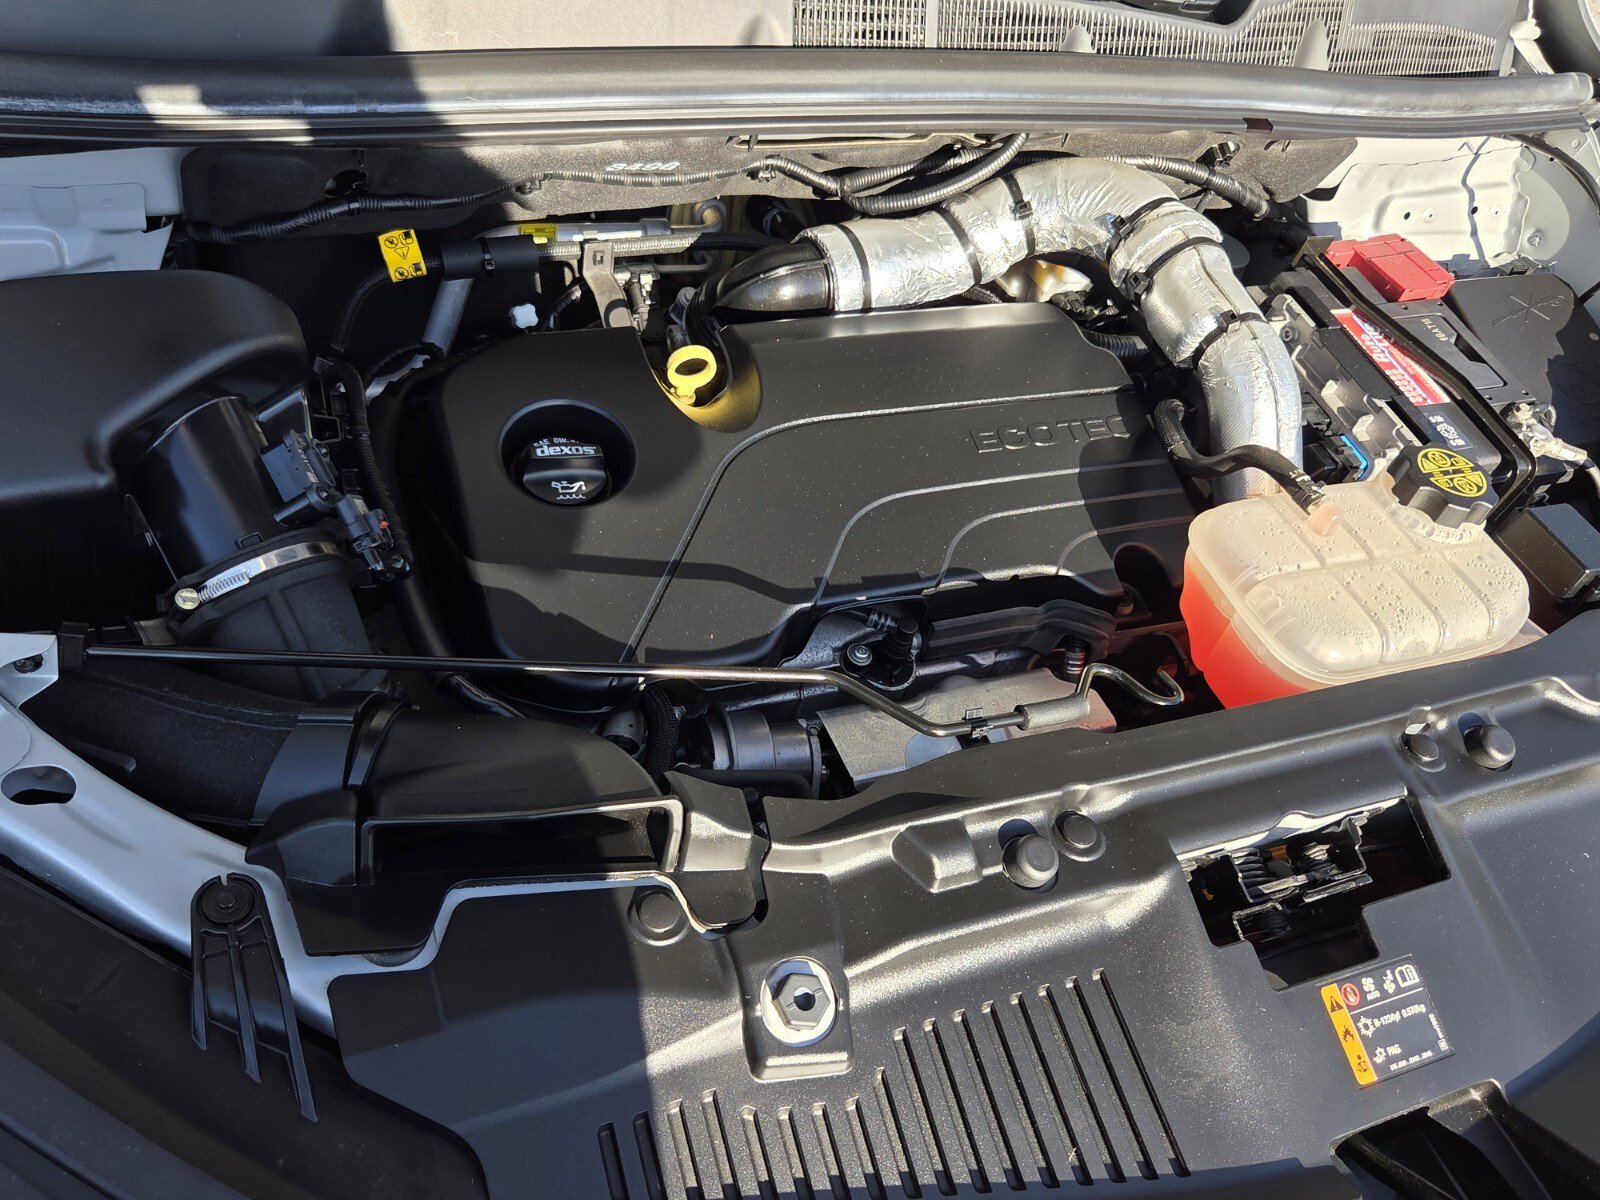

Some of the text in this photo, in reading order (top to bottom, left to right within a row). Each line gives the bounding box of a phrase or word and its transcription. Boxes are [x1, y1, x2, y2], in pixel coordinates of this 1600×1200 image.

[969, 414, 1132, 454] ECOTEC
[535, 444, 597, 457] dexos
[1366, 990, 1381, 1001] AUTO
[1386, 1043, 1402, 1056] PAG
